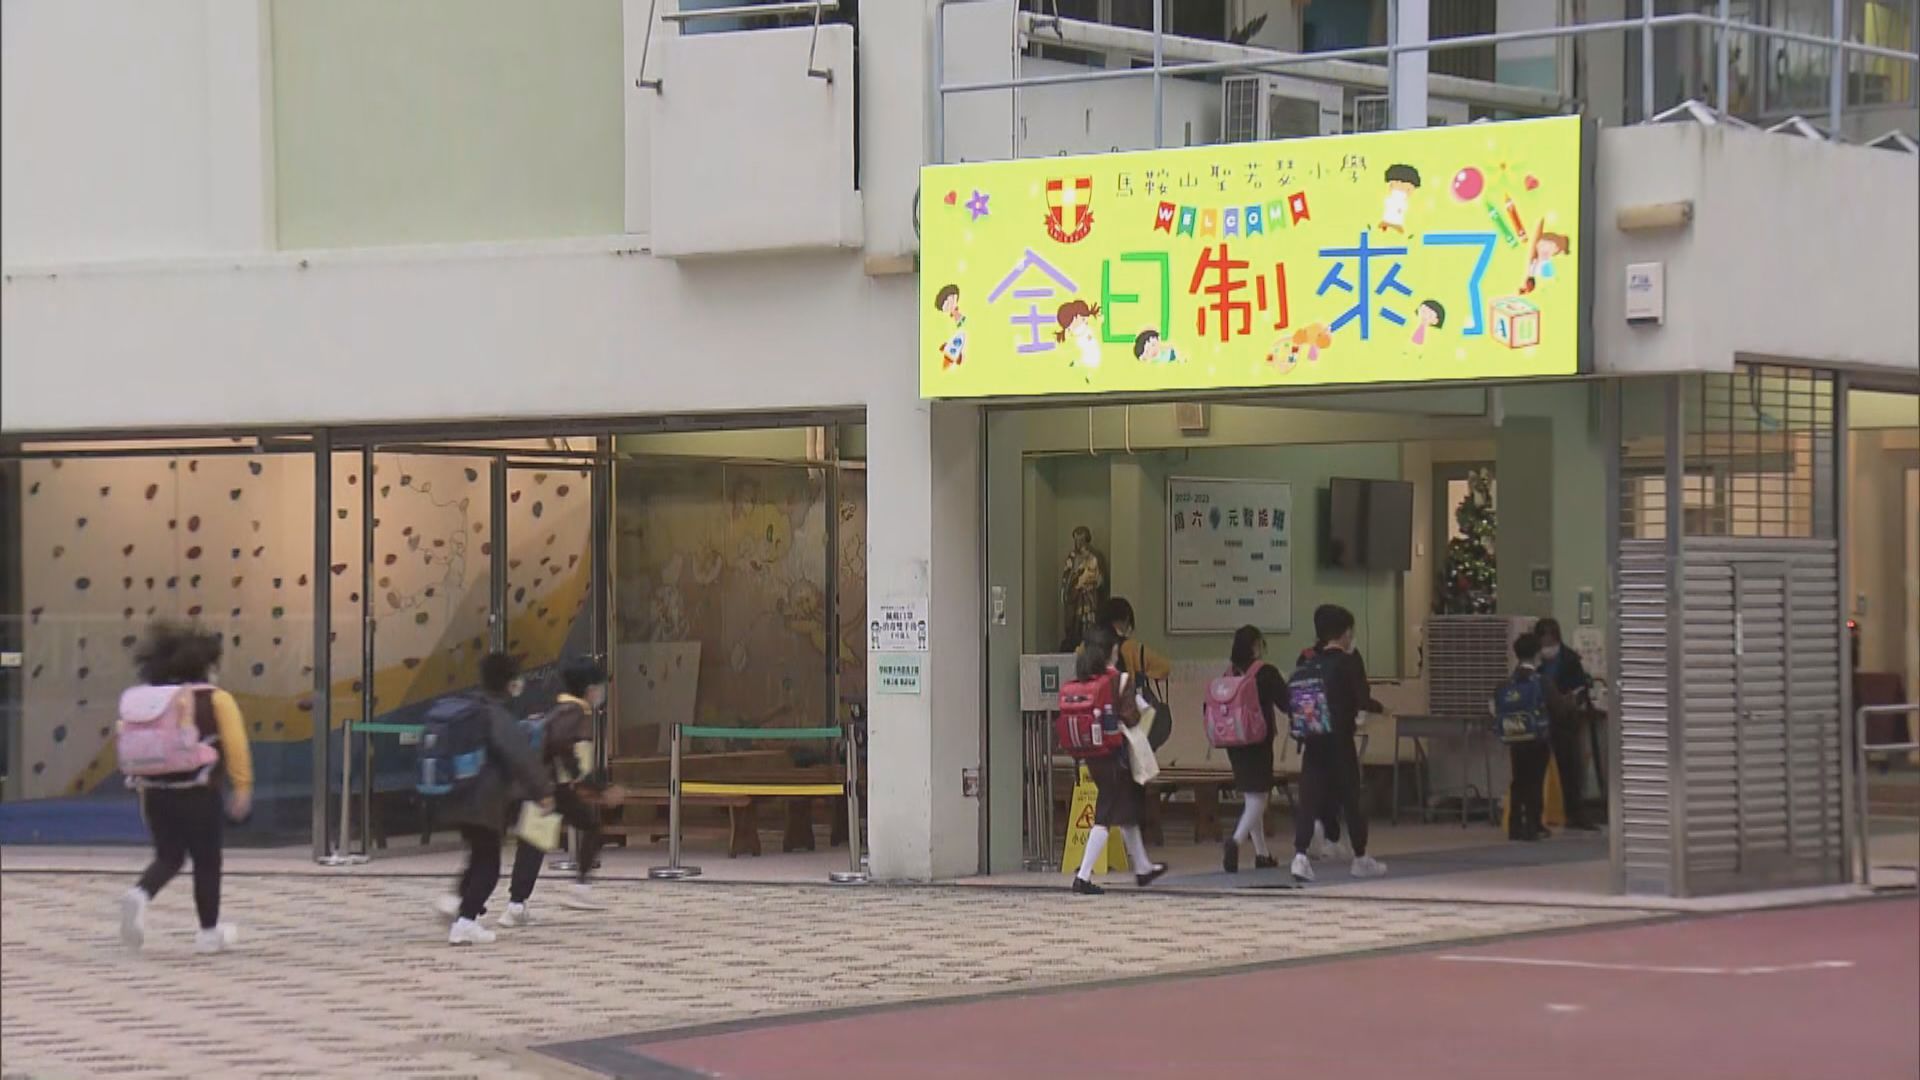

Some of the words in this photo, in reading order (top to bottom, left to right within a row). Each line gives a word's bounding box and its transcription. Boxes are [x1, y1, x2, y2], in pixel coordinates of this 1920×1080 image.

[1156, 194, 1306, 230] WELCOME
[987, 230, 1497, 353] 全日制來了
